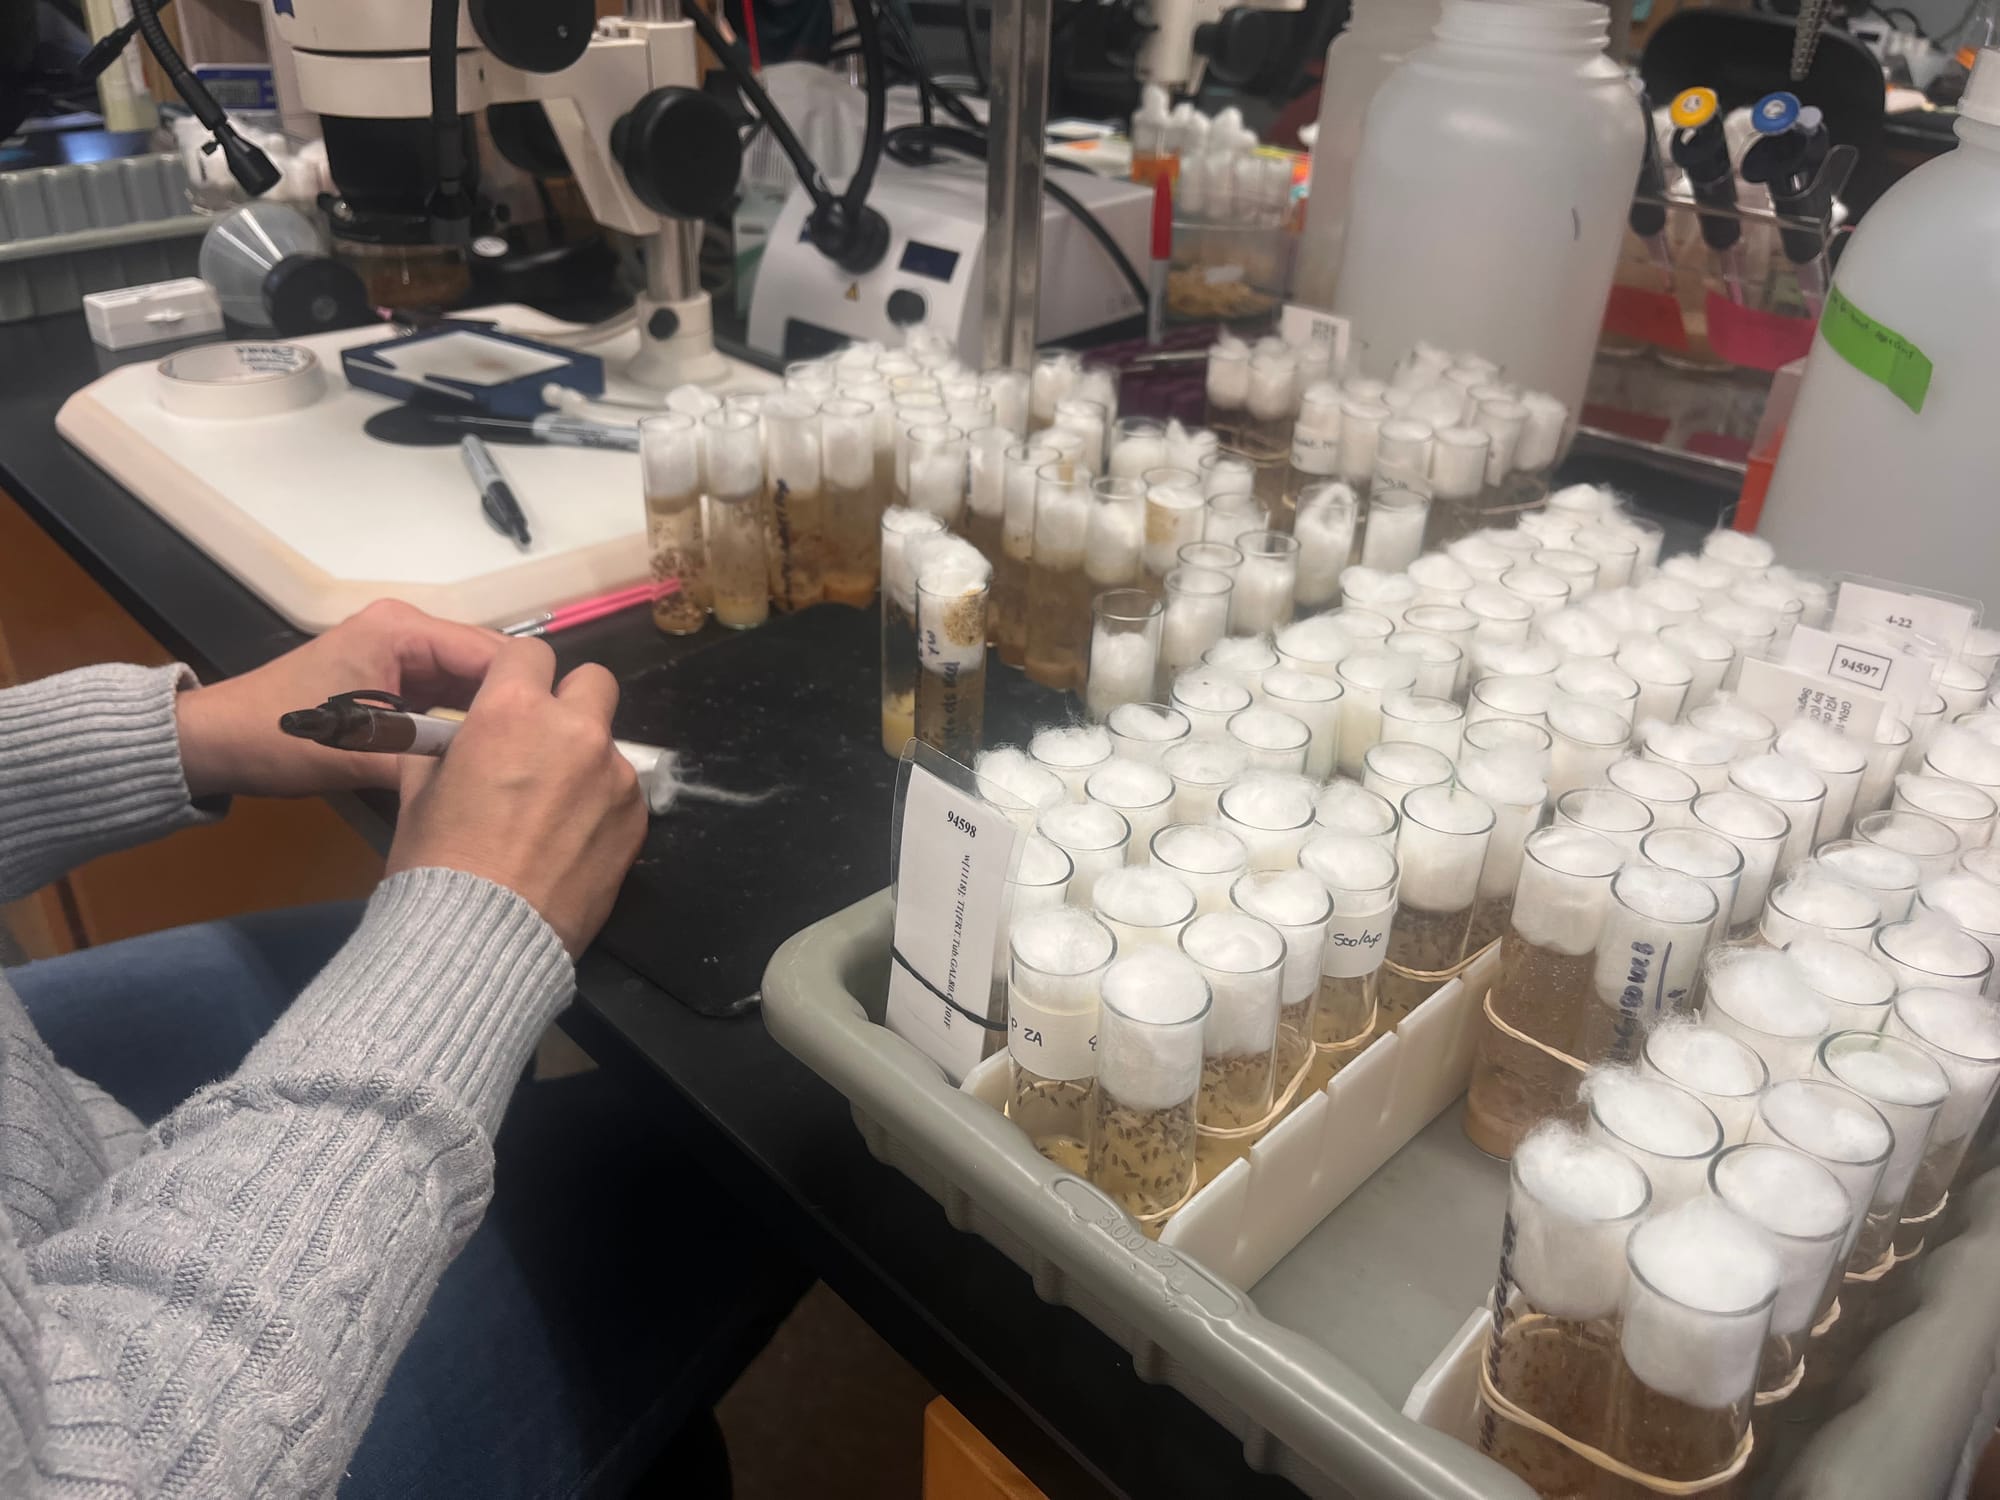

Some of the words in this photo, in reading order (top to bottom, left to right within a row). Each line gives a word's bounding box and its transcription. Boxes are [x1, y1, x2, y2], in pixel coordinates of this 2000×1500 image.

[1886, 615, 1913, 629] 4-22
[1840, 658, 1880, 678] 94597
[947, 810, 977, 838] 94598
